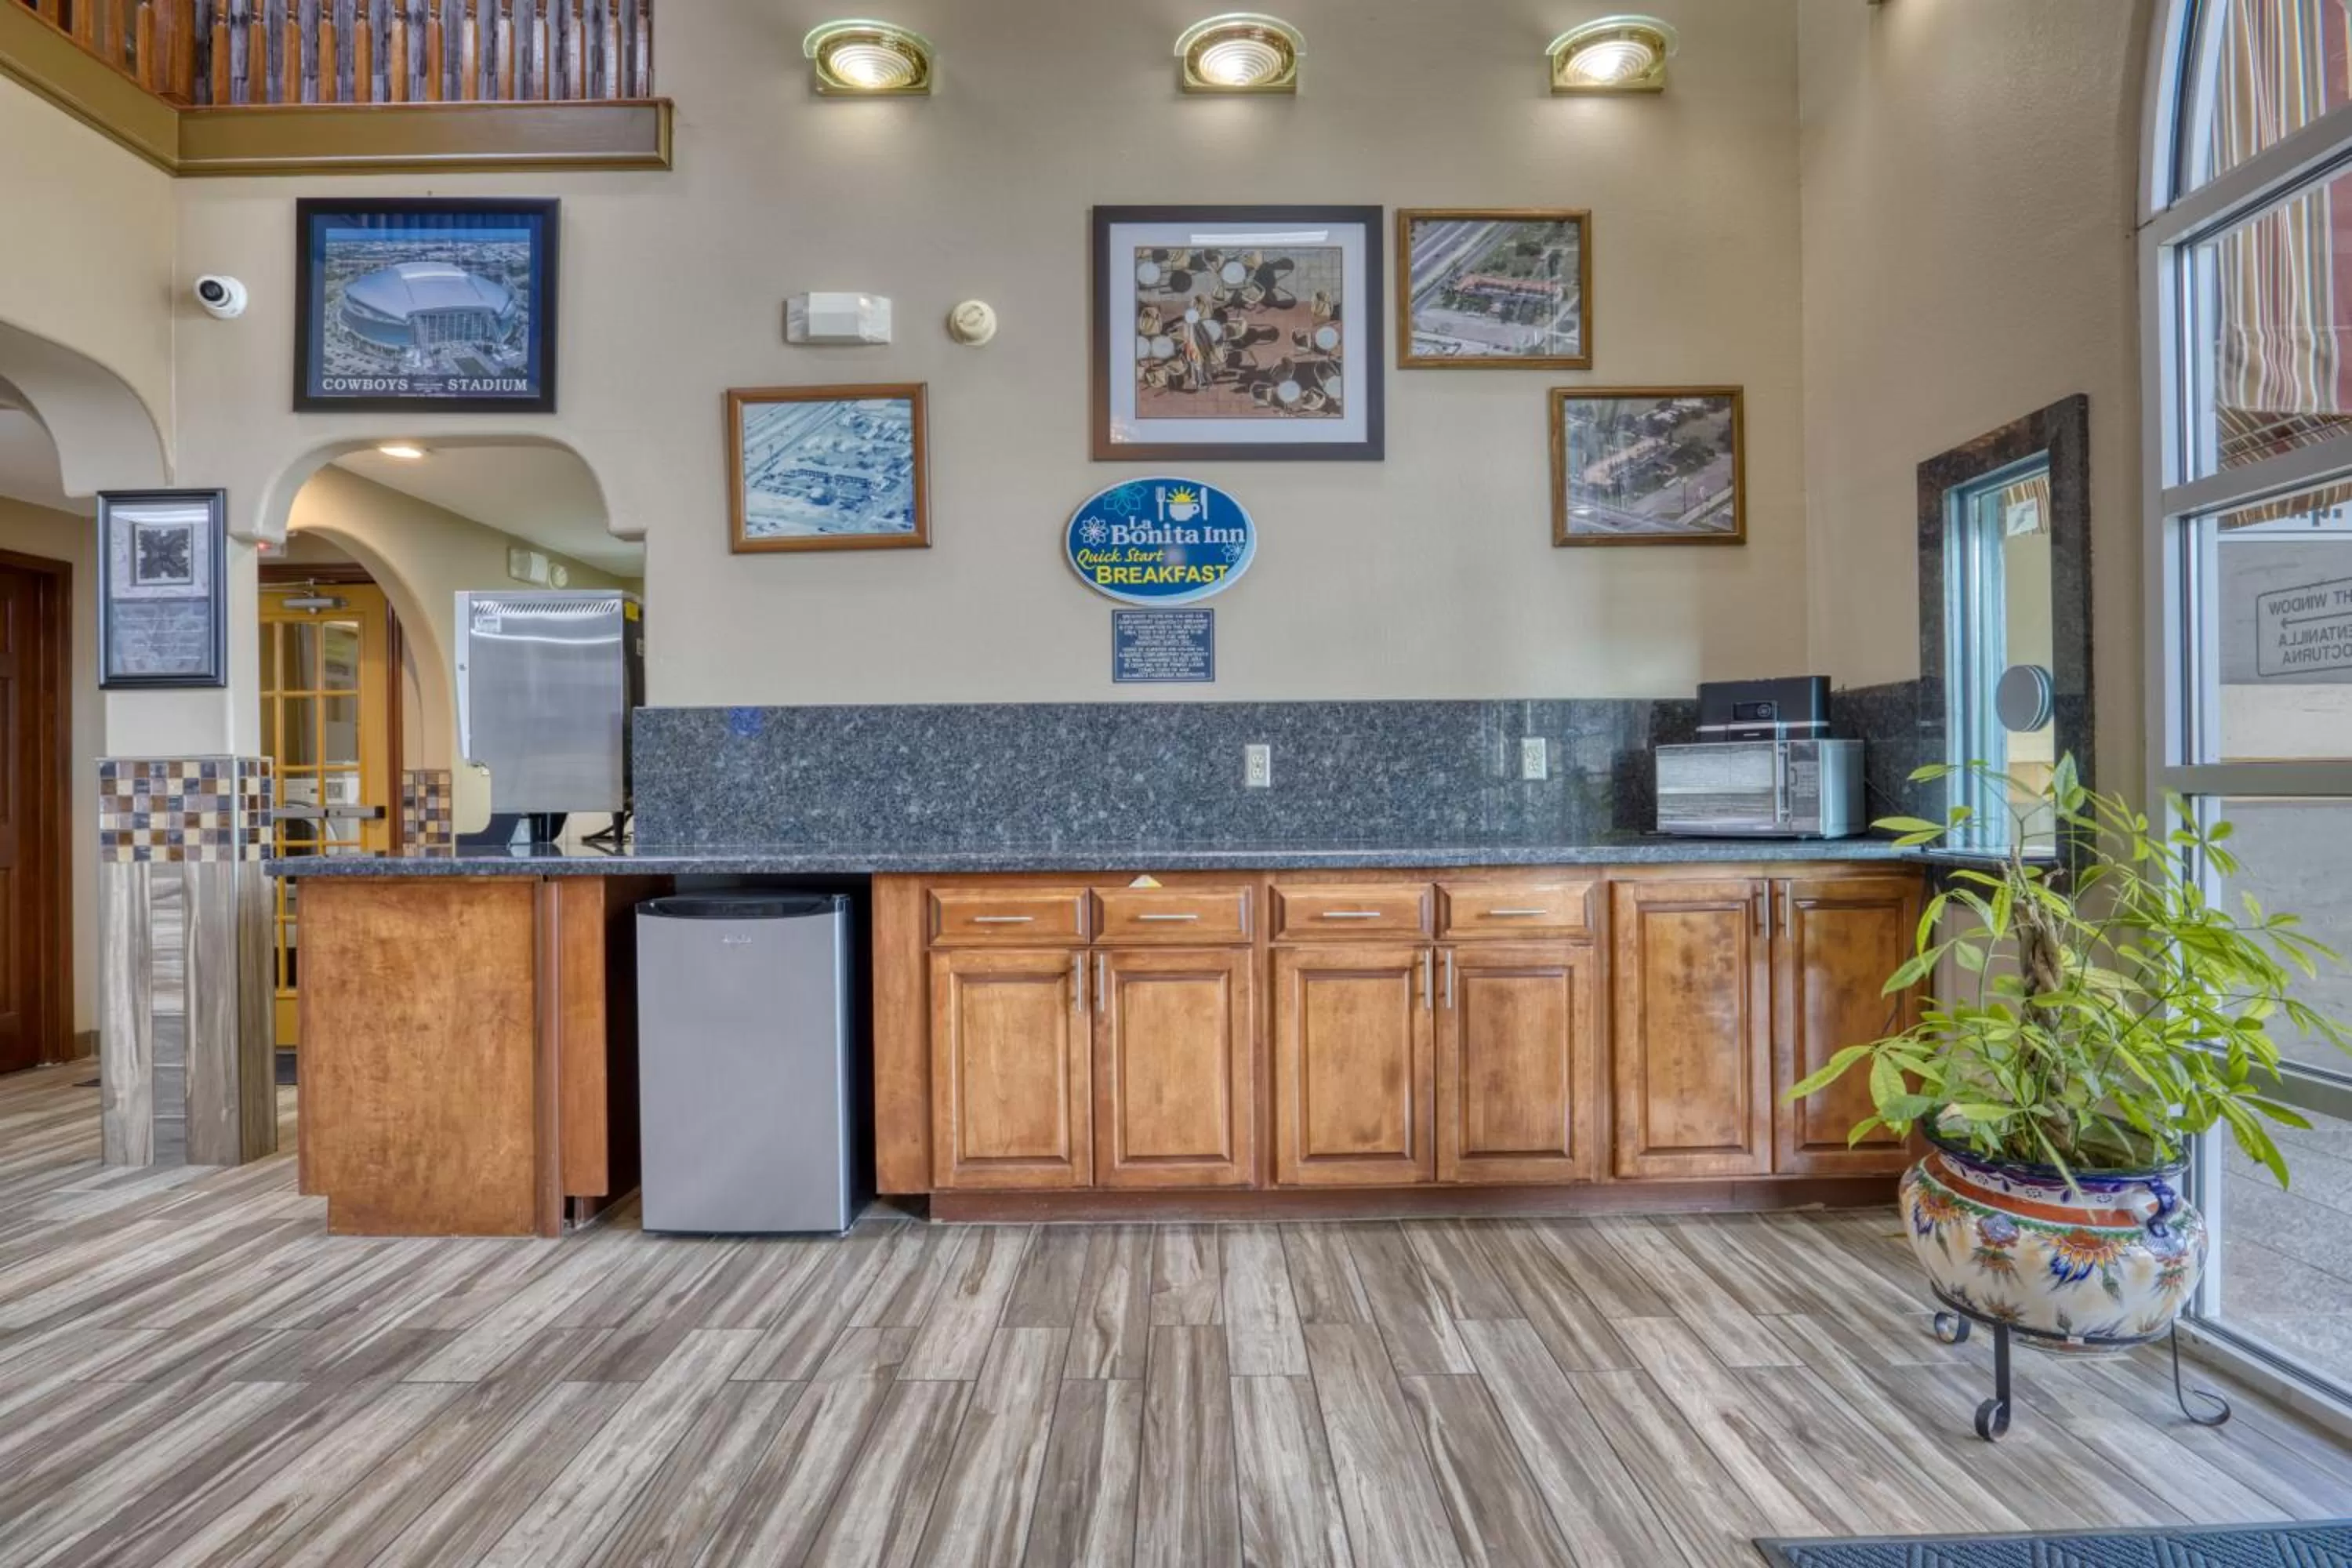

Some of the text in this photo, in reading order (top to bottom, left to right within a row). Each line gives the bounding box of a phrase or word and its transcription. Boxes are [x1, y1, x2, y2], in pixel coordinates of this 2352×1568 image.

[321, 378, 408, 391] COWBOYS
[447, 378, 528, 391] STADIUM
[1128, 516, 1152, 529] La
[1110, 523, 1246, 545] Bonita Inn
[1077, 548, 1166, 570] Quick Start
[1098, 564, 1229, 584] BREAKFAST
